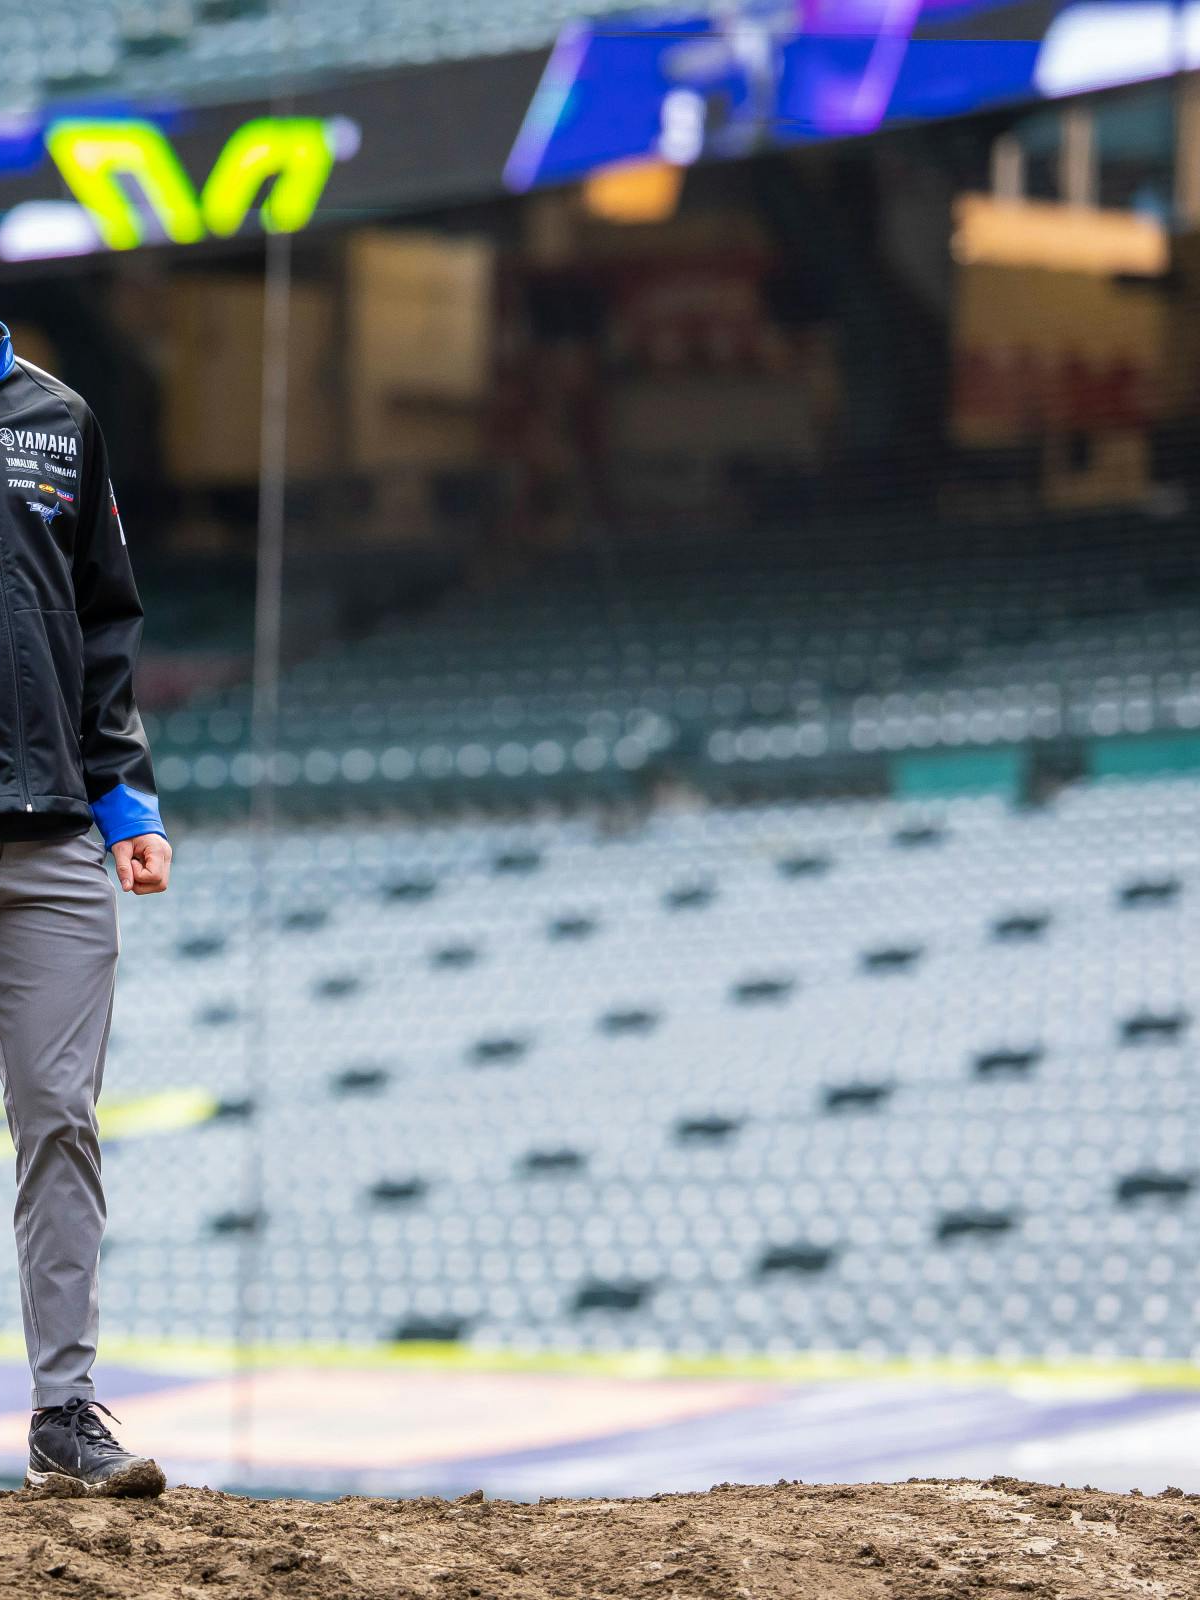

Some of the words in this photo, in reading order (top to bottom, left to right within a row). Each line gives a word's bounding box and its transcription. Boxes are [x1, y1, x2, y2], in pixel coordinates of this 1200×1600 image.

[15, 430, 77, 455] YAMAHA
[6, 446, 73, 461] RACING
[5, 457, 40, 470] YAMALUBE
[51, 465, 77, 479] YAMAHA
[7, 479, 36, 489] THOR
